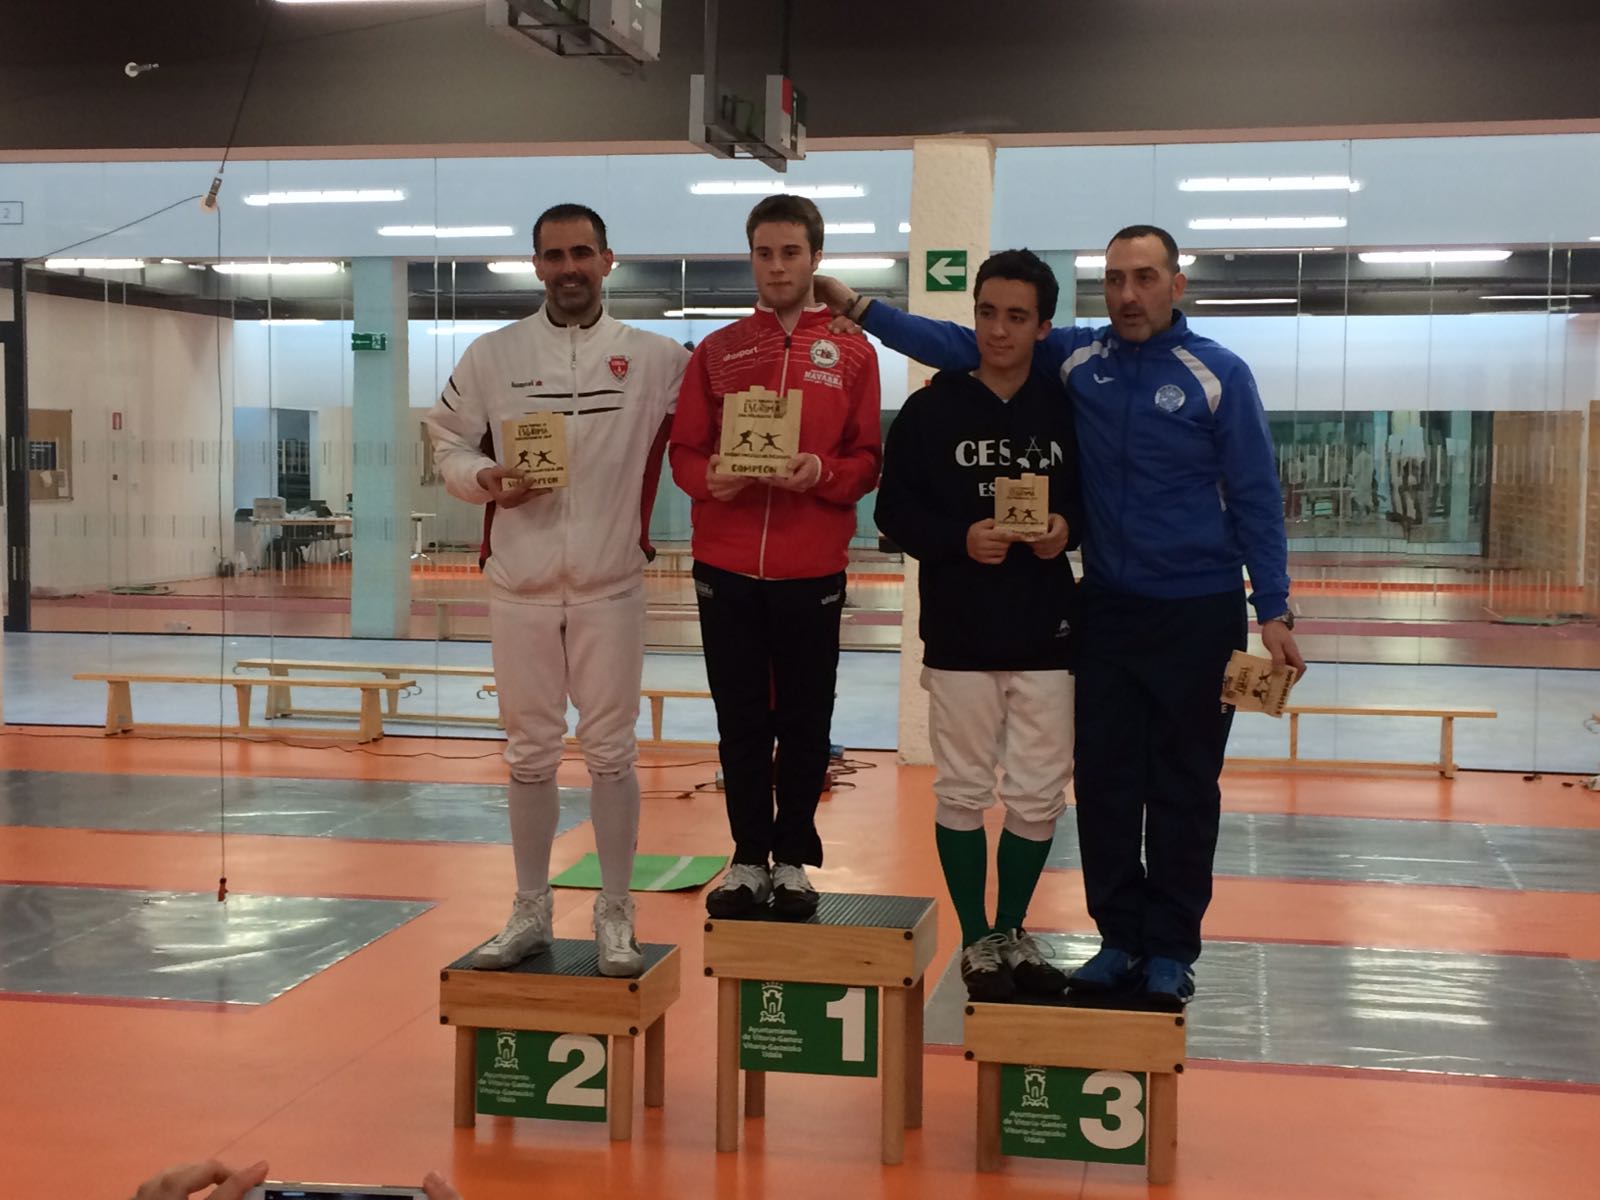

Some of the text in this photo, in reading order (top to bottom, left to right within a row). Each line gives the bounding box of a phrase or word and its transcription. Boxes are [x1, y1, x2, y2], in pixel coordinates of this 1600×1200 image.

[826, 987, 865, 1062] 1
[546, 1033, 606, 1108] 2
[1079, 1070, 1145, 1150] 3
